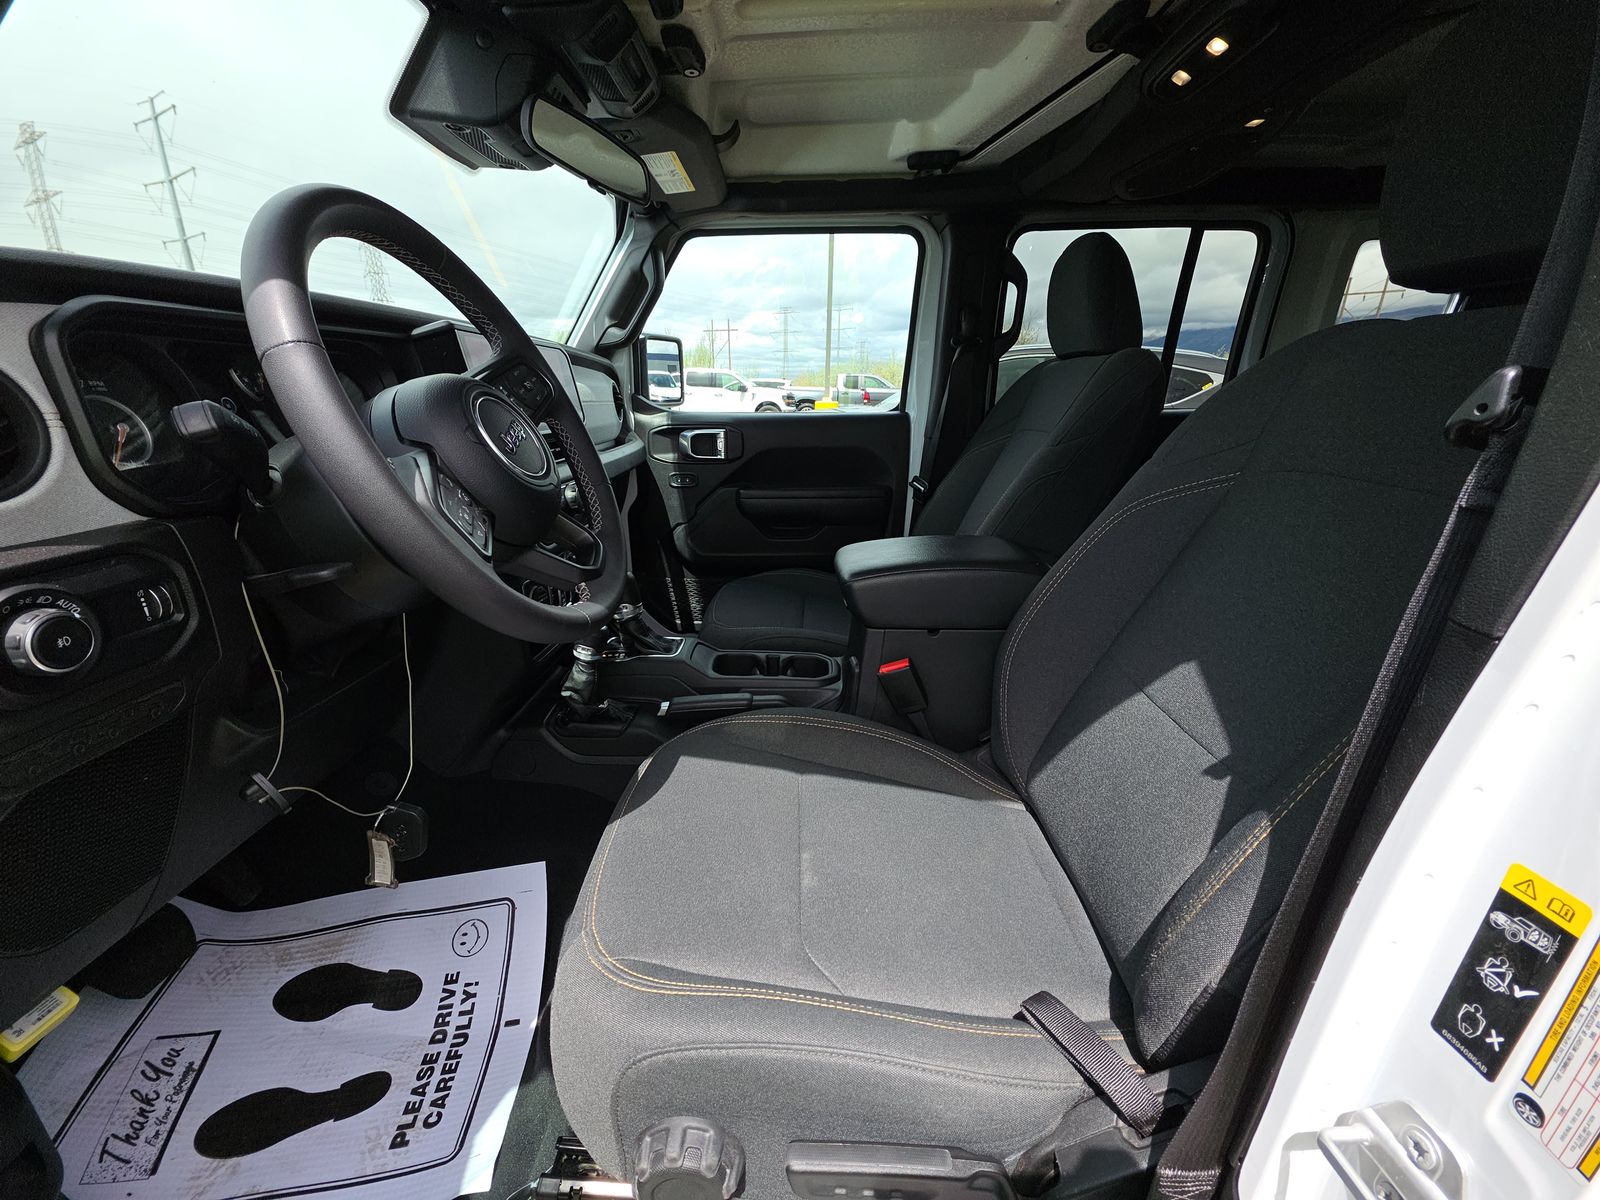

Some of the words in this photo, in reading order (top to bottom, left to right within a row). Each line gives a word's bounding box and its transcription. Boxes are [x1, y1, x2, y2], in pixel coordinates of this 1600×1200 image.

[55, 598, 81, 614] AUTO
[1550, 1027, 1561, 1040] TIRE
[1558, 1016, 1567, 1028] AND
[1563, 995, 1580, 1017] LOADING
[1576, 959, 1599, 996] INFORMATION
[388, 1050, 441, 1150] PLEASE
[428, 971, 461, 1045] DRIVE
[422, 981, 480, 1130] CAREFULLY!
[98, 1089, 160, 1164] Thank
[140, 1047, 185, 1082] You
[144, 1129, 162, 1147] For
[154, 1105, 173, 1127] Your
